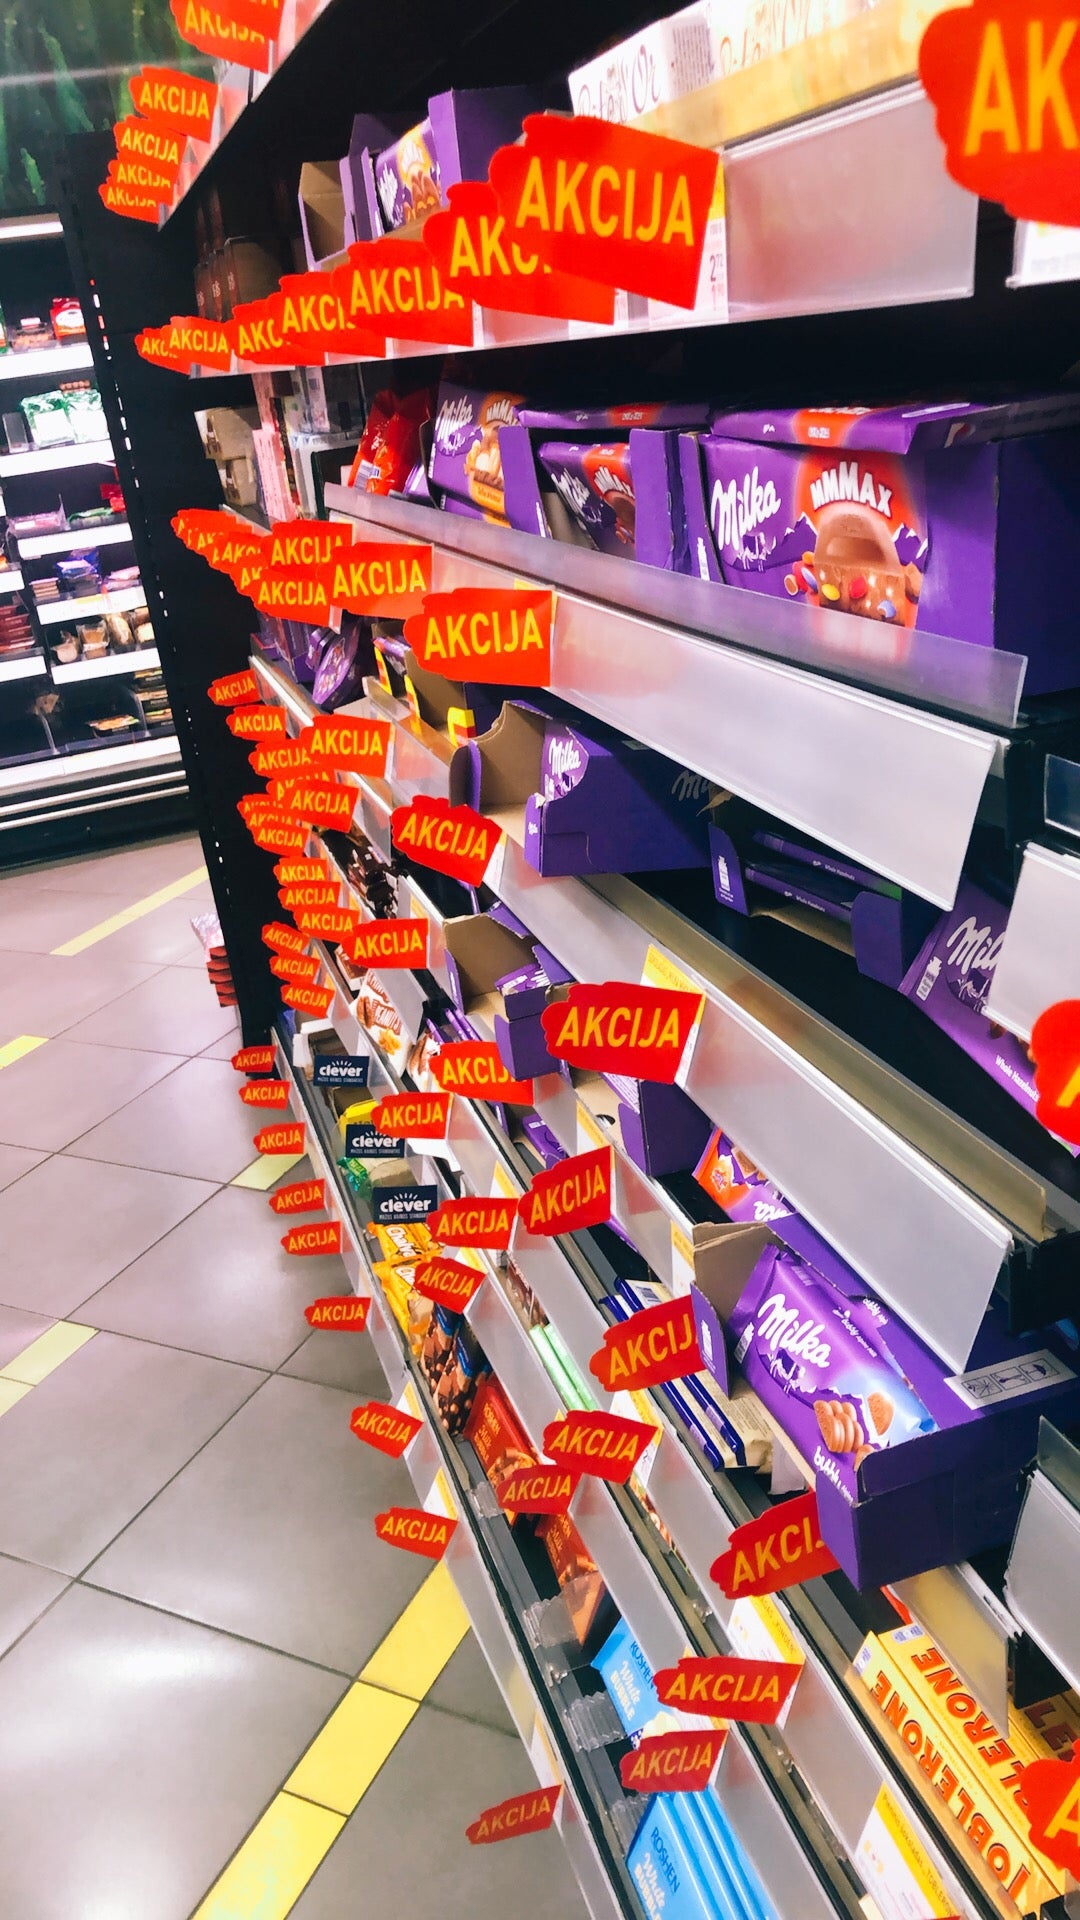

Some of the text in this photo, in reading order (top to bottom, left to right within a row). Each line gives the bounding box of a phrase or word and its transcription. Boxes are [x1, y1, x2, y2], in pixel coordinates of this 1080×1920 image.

[139, 81, 210, 119] AKCIJA
[120, 127, 178, 165] AKCIJA
[516, 156, 694, 246] AKCIJA
[282, 294, 356, 333] AKCI
[170, 327, 228, 354] AKCIJA
[810, 461, 893, 518] MMMAX
[711, 465, 782, 551] Milka
[333, 559, 427, 598] AKCIJA
[258, 581, 327, 606] AKCIJA
[424, 608, 543, 661] AKCIJA
[215, 676, 255, 702] AKCIJA
[233, 714, 283, 732] AKCIJA
[310, 729, 383, 757] AKCIJA
[549, 737, 582, 777] Milka
[290, 789, 350, 815] AKCIJA
[257, 828, 303, 848] AKCIJA
[398, 813, 489, 861] AKCIJA
[280, 865, 325, 882] AKCIJA
[285, 888, 336, 906] AKCIJA
[301, 912, 354, 932] AKCIJA
[264, 927, 303, 952] AKCIJA
[353, 928, 424, 960] AKCIJA
[946, 916, 1007, 976] Mil
[273, 958, 315, 976] AKCIJA
[284, 989, 327, 1009] AKCIJA
[556, 1007, 679, 1048] AKCIJA
[235, 1049, 272, 1068] AKCIJA
[319, 1064, 363, 1077] clever
[442, 1055, 528, 1085] AKCIJ
[243, 1086, 286, 1101] AKCIJA
[380, 1101, 443, 1128] AKCIJA
[259, 1130, 301, 1149] AKCIJA
[352, 1135, 400, 1148] clever
[277, 1187, 322, 1210] AKCIJA
[380, 1199, 432, 1213] clever
[530, 1164, 607, 1228] AKCIJA
[436, 1211, 508, 1237] AKCIJA
[288, 1229, 338, 1251] AKCIJA
[420, 1267, 475, 1298] AKCIJA
[311, 1303, 365, 1322] AKCIJA
[757, 1293, 833, 1370] Milka
[609, 1313, 698, 1384] AKCIJ
[352, 1412, 412, 1445] AKCIJA
[549, 1426, 639, 1462] AKCIJA
[502, 1475, 572, 1503] AKCIJA
[381, 1520, 448, 1544] AKCIJA
[732, 1516, 824, 1591] AKCI
[665, 1674, 780, 1702] AKCIJA
[629, 1742, 712, 1781] AKCIJA
[477, 1796, 550, 1841] AKCIJA
[651, 1826, 680, 1894] ROSHEN
